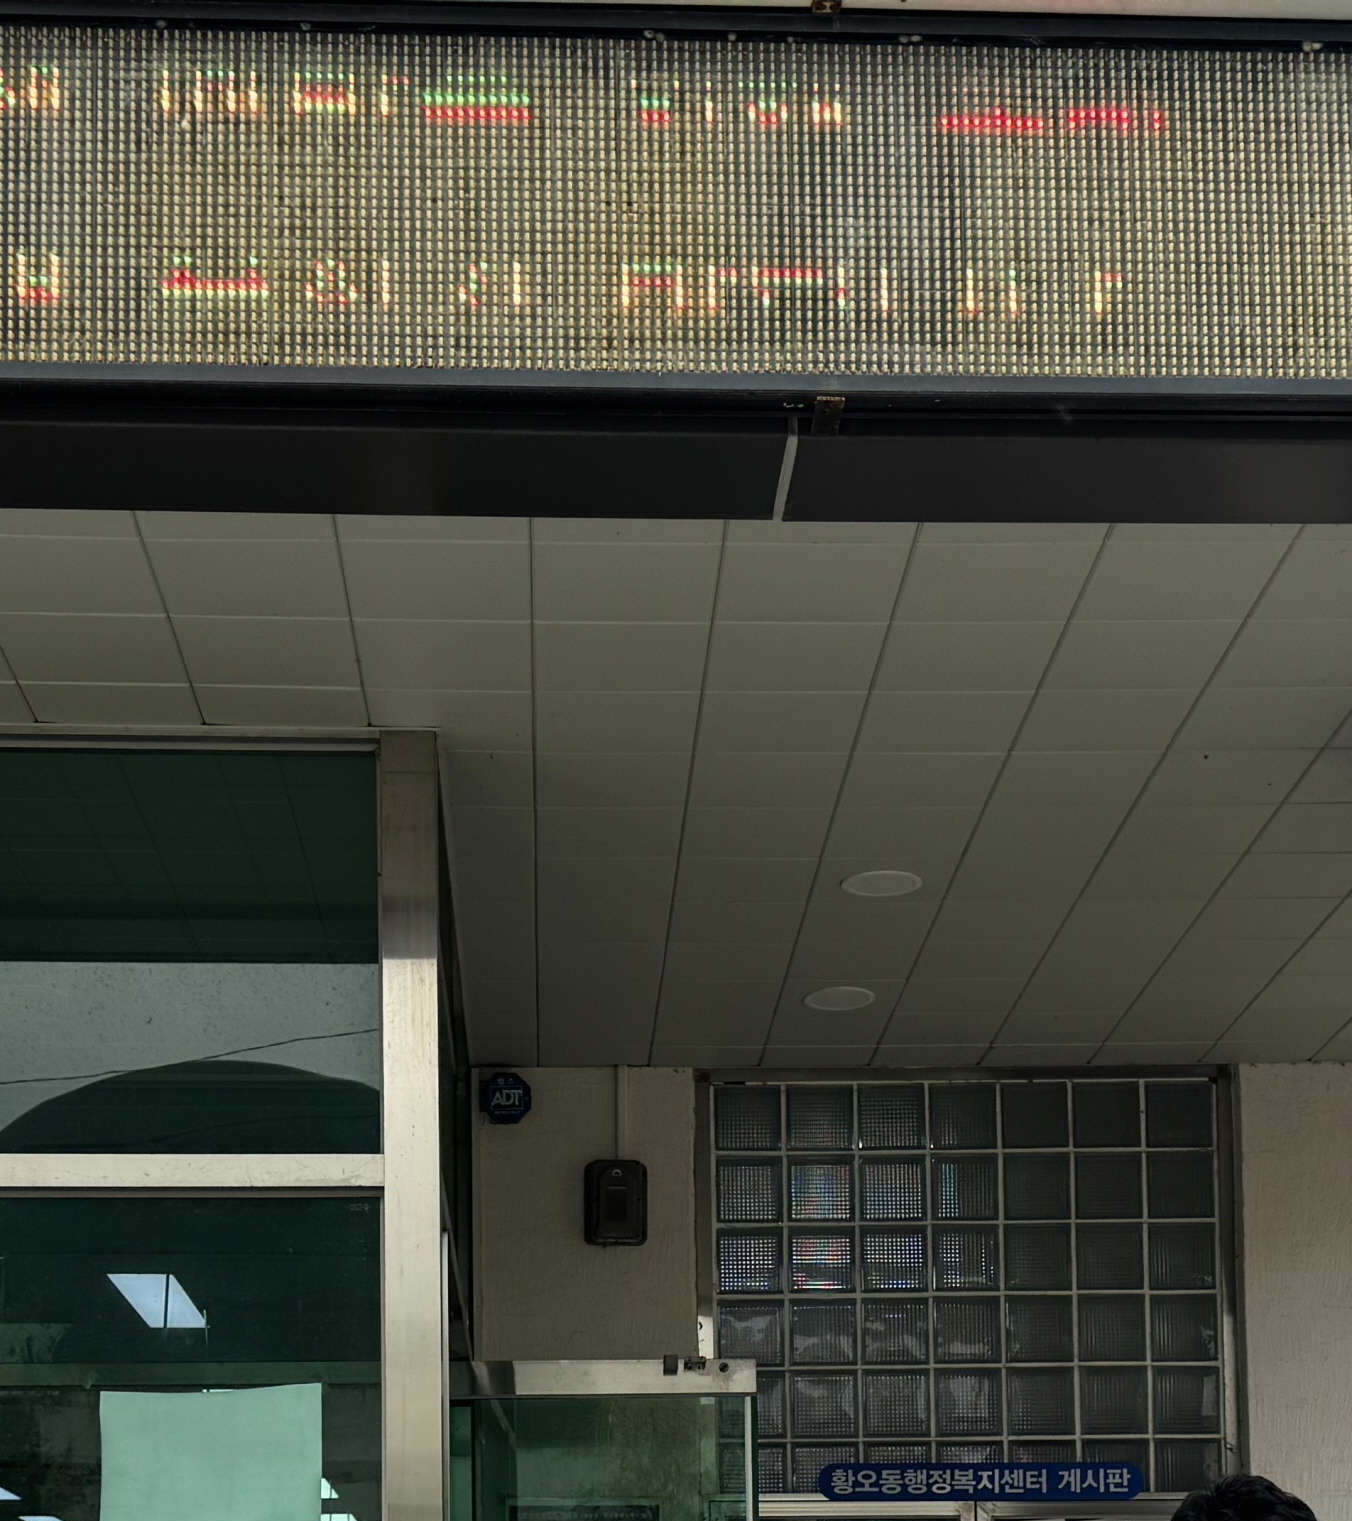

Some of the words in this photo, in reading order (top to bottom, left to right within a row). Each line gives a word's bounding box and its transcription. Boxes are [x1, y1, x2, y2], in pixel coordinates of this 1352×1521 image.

[491, 1090, 522, 1105] ADT
[831, 1468, 1046, 1494] 황오동행정복지센터
[1058, 1468, 1130, 1493] 게시판
